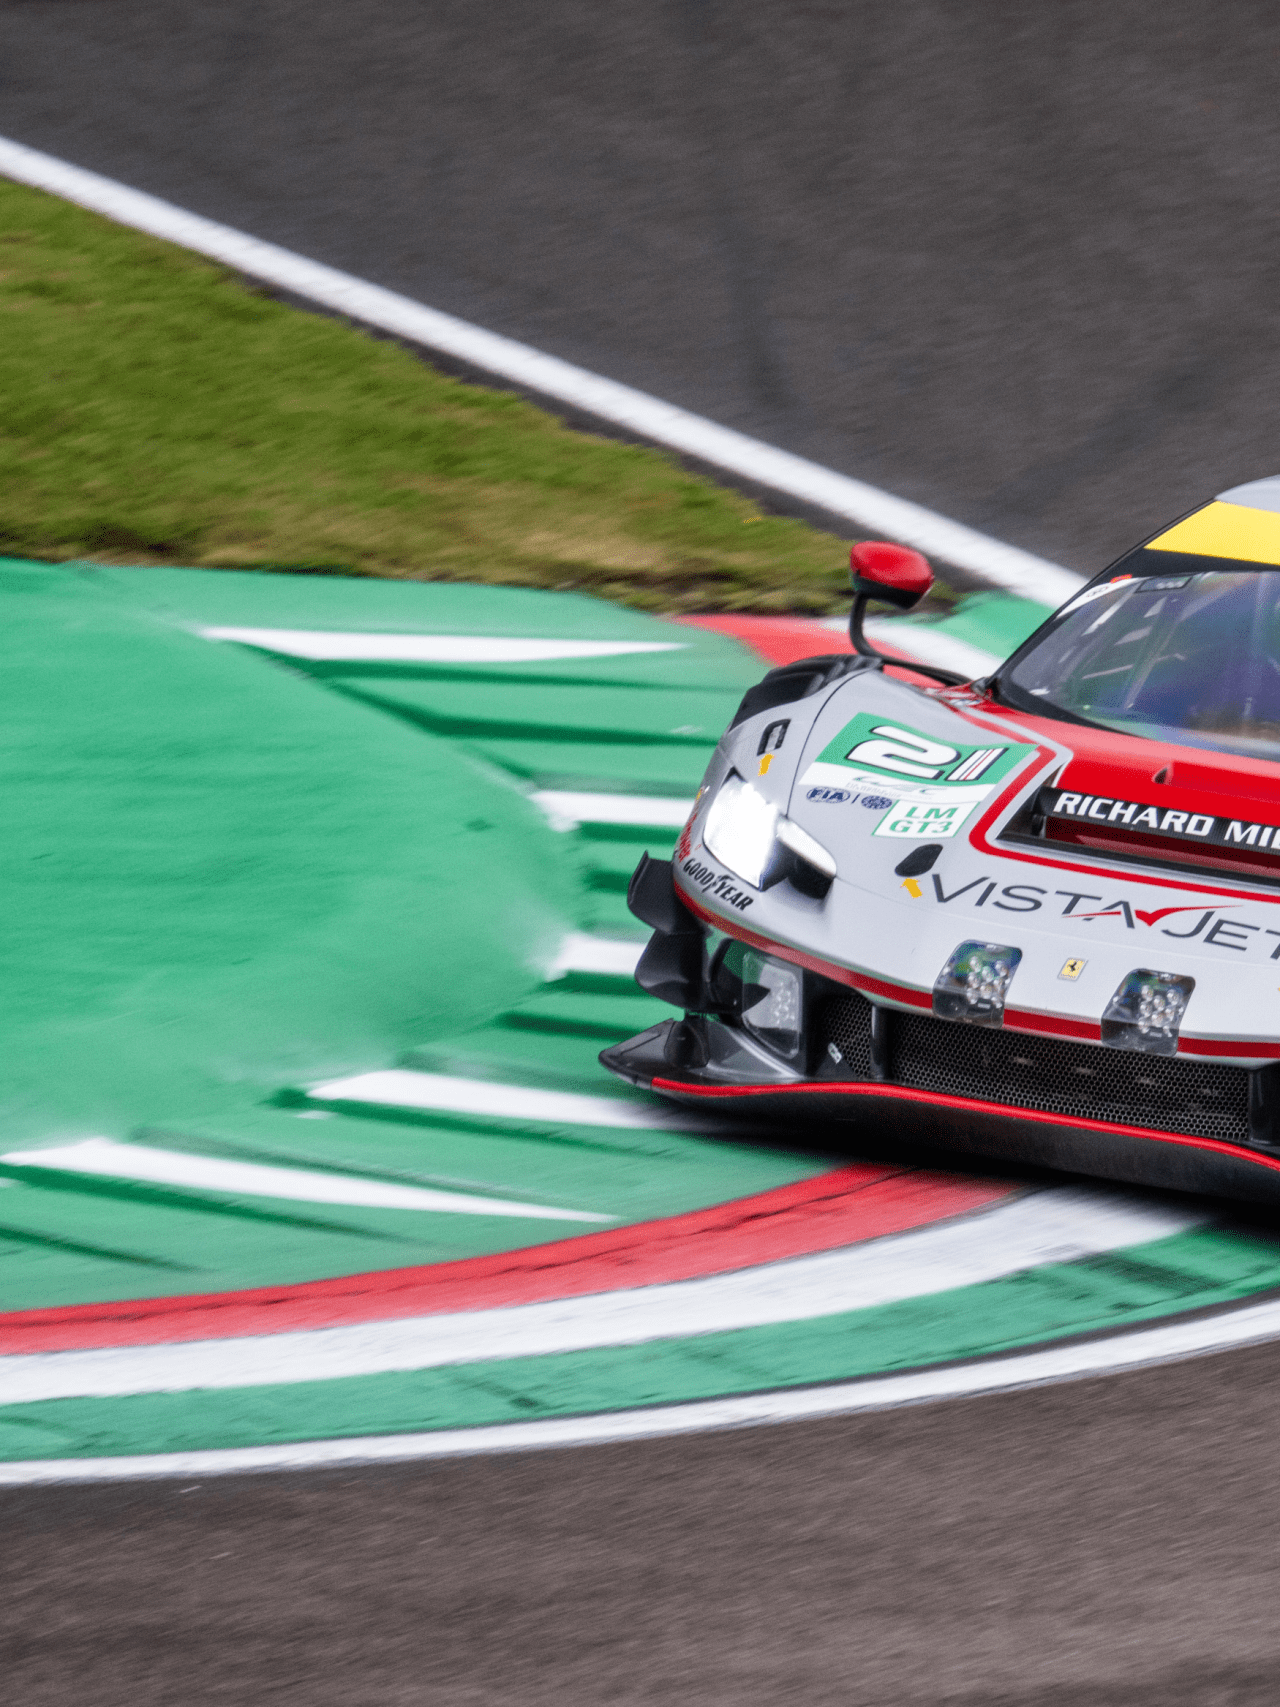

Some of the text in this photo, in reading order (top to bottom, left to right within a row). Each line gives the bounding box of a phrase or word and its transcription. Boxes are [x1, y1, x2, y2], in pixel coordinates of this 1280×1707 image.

[846, 725, 1010, 781] 21
[888, 819, 954, 834] GT3
[903, 806, 960, 820] LM
[1052, 791, 1215, 837] RICHARD
[683, 858, 754, 911] GOODYEAR
